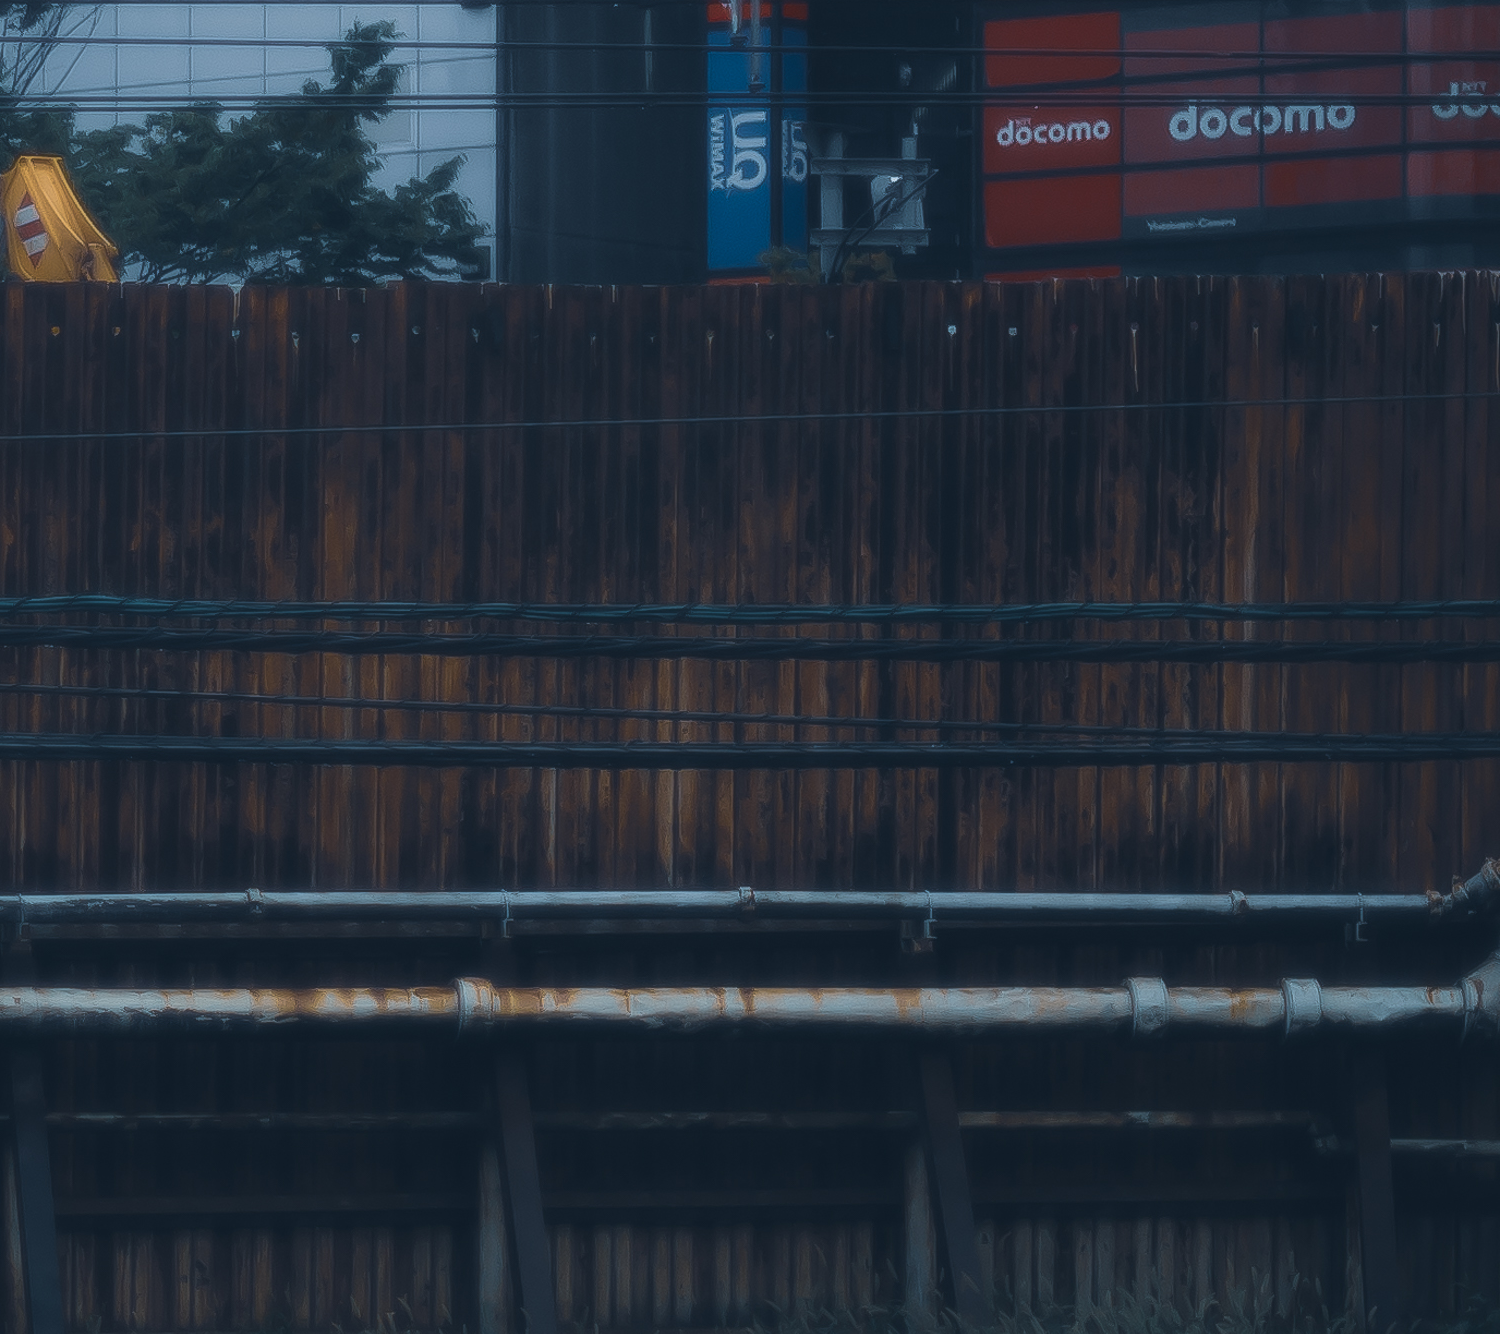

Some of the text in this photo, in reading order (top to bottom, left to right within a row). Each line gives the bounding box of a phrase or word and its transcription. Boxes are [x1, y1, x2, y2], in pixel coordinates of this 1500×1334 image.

[996, 117, 1112, 147] docomo
[1168, 98, 1357, 141] docomo
[730, 110, 767, 189] UQ
